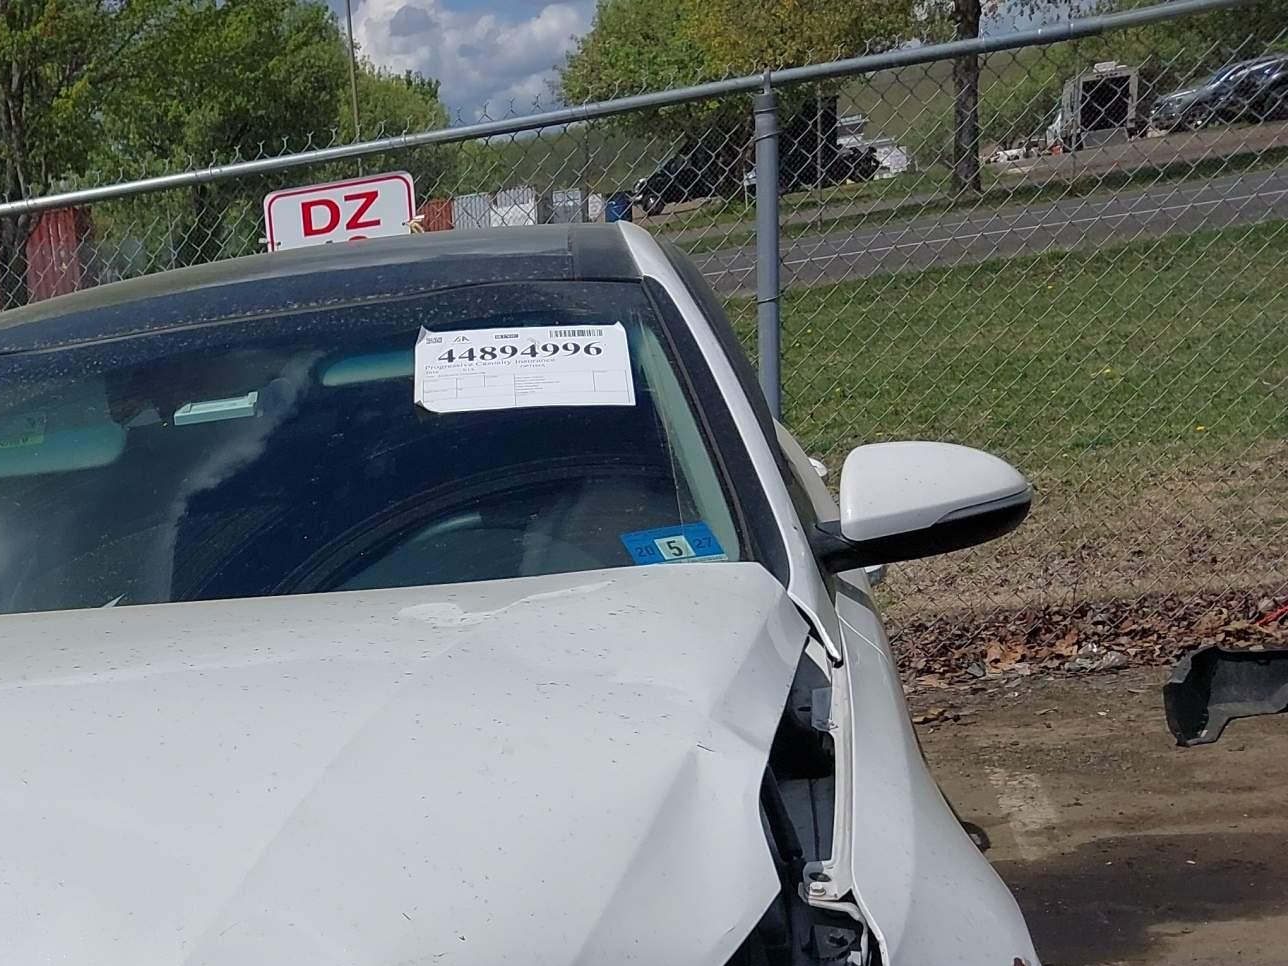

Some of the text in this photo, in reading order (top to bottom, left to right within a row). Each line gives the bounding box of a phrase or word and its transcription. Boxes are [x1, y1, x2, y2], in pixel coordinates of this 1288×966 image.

[300, 190, 382, 237] DZ
[438, 341, 603, 363] 44894996
[634, 536, 712, 558] 20 5 27
